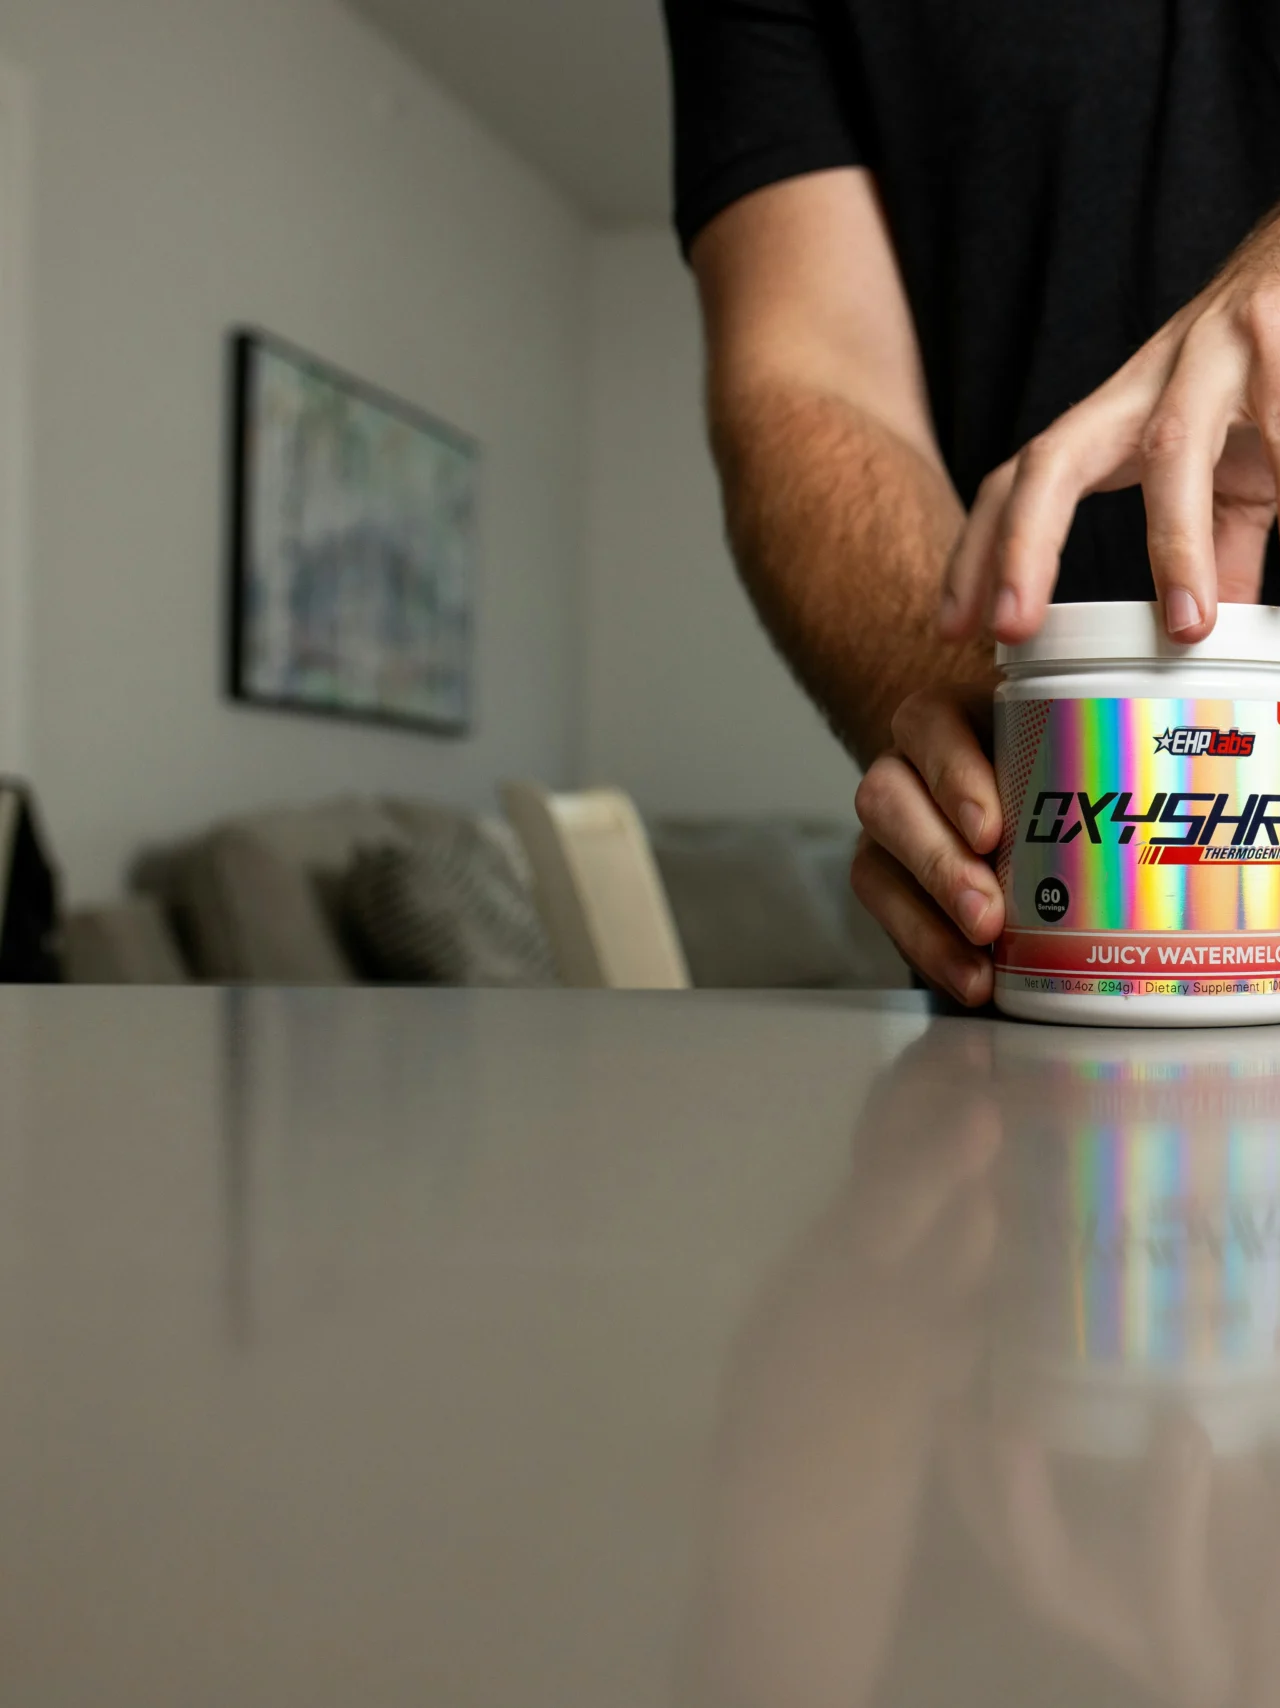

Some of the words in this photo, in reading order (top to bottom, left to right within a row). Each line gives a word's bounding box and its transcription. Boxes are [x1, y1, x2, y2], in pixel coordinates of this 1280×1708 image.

[1041, 889, 1061, 903] 60
[1038, 904, 1065, 912] Servings
[1086, 945, 1151, 965] JUICY
[1024, 977, 1038, 989] Net
[1040, 978, 1057, 990] Wt.
[1060, 980, 1094, 993] 10.4oz
[1097, 980, 1134, 995] (294g)
[1145, 981, 1190, 996] Dietary
[1193, 982, 1260, 996] Supplement
